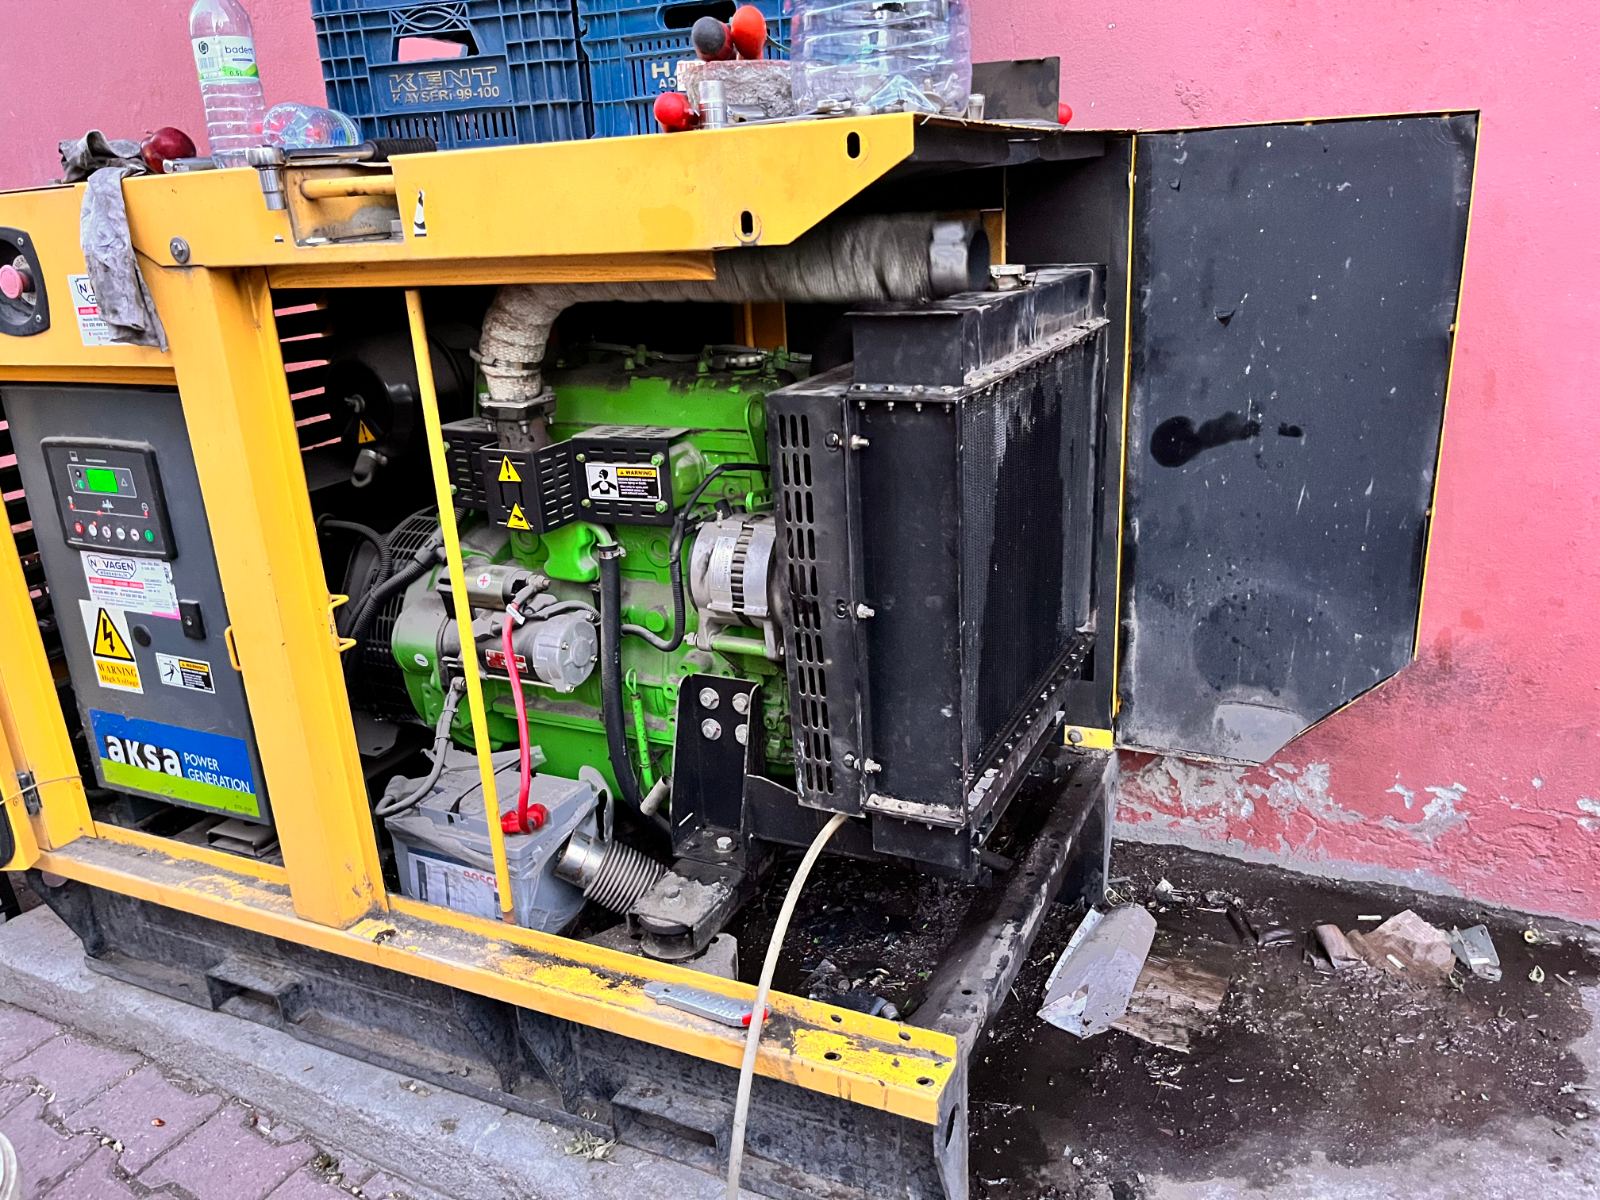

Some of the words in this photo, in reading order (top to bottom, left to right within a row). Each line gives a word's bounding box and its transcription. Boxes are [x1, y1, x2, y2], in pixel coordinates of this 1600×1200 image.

[389, 66, 497, 92] KENT
[98, 663, 137, 678] WARNING
[105, 735, 183, 778] aksa
[183, 752, 220, 771] POWER
[188, 769, 251, 794] GENERATION
